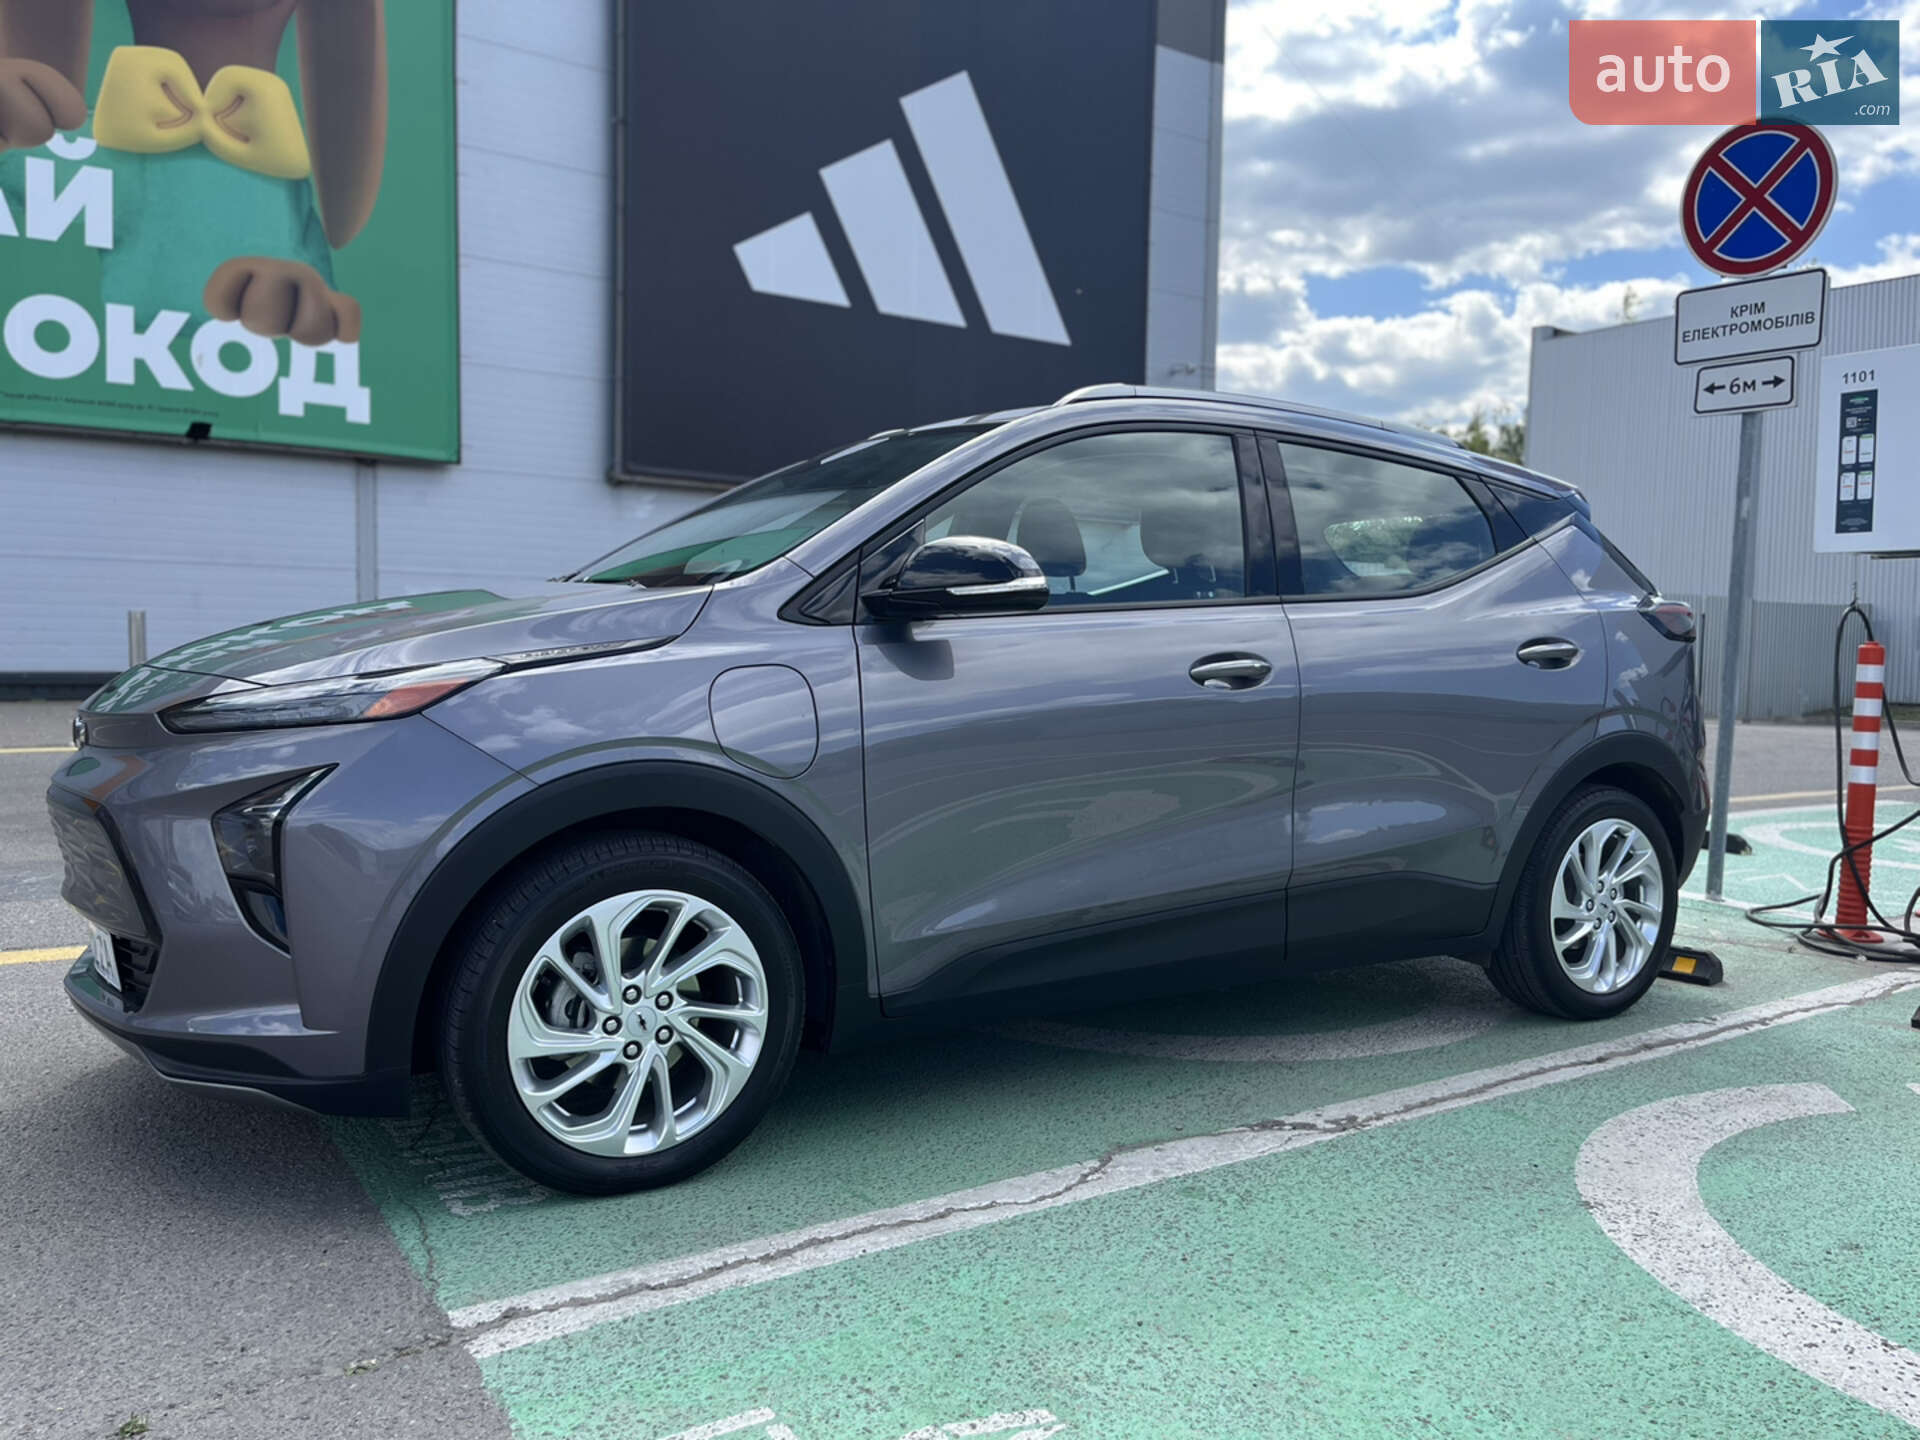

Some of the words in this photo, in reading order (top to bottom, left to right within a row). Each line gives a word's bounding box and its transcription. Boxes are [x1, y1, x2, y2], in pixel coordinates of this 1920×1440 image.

[0, 133, 114, 250] Й
[1730, 301, 1766, 319] КРІМ
[1682, 311, 1816, 343] ЕЛЕКТРОМОБІЛІВ
[3, 293, 371, 424] ОКОД
[1842, 369, 1876, 385] 1101
